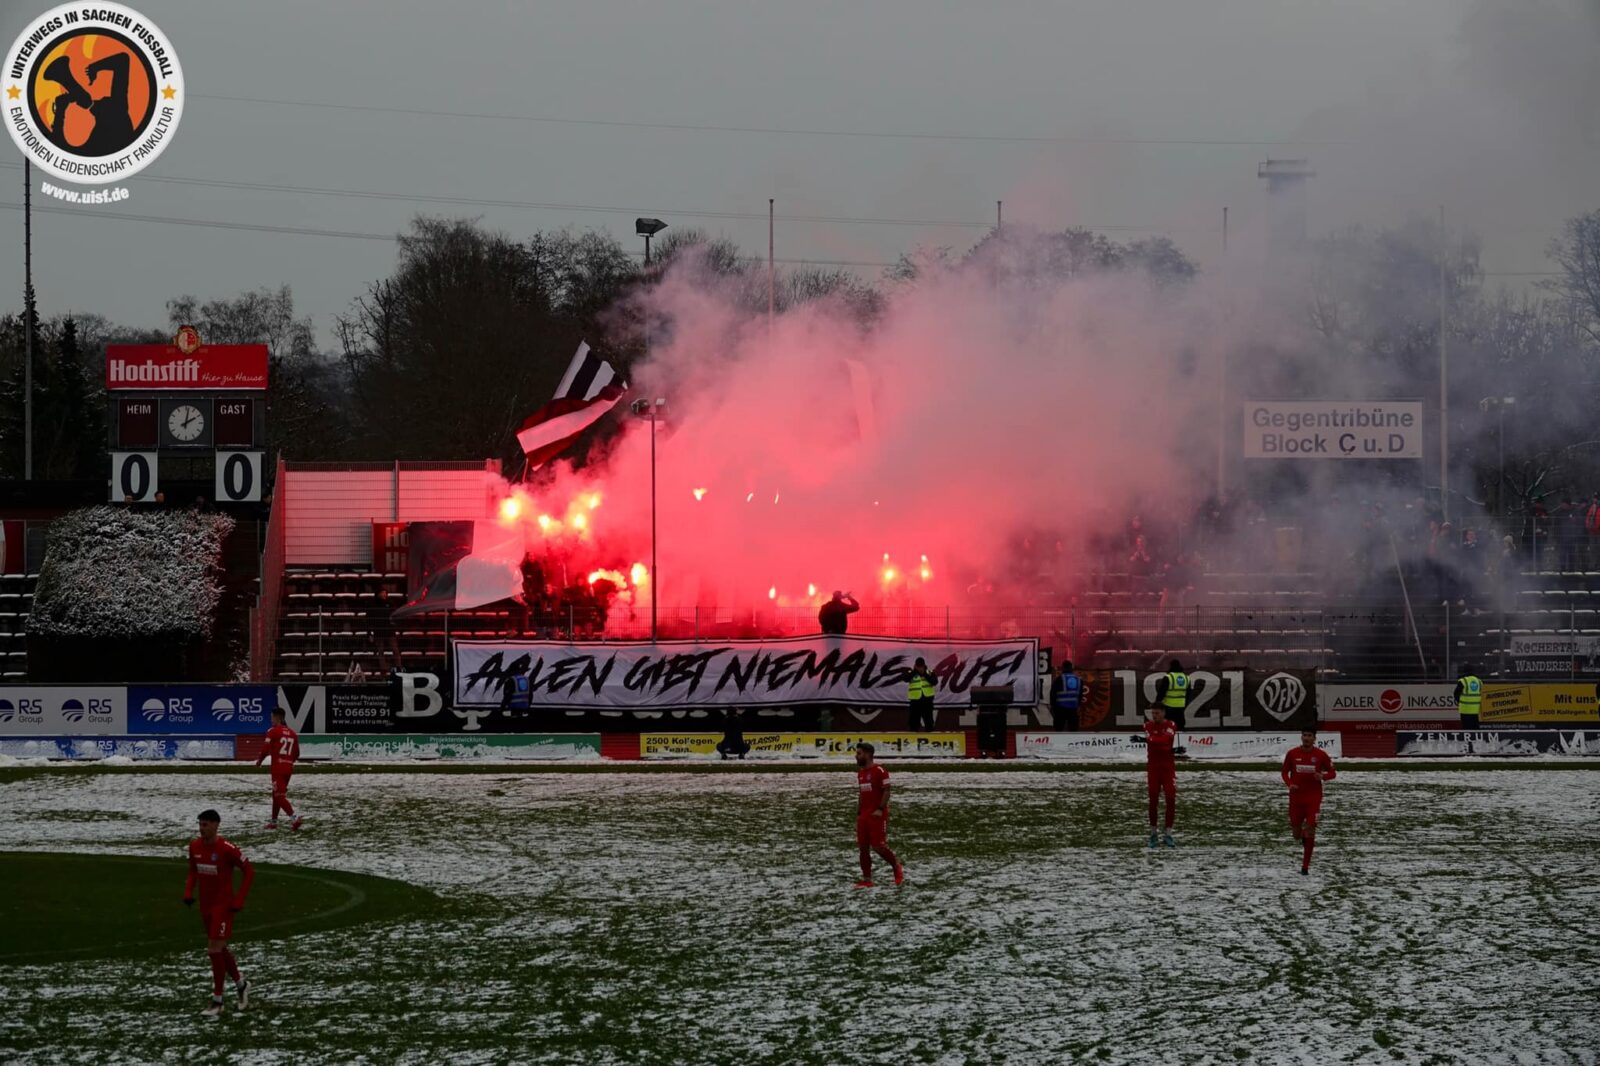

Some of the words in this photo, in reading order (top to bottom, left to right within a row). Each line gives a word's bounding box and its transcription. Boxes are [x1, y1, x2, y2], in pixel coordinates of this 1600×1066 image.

[110, 359, 200, 382] Hochstift
[126, 405, 151, 415] HEIM
[220, 405, 246, 415] GAST
[1253, 408, 1414, 431] Gegentribüne
[1262, 434, 1327, 452] Block
[1339, 433, 1356, 453] C
[1364, 439, 1382, 453] u.
[1389, 434, 1404, 452] D
[120, 454, 150, 501] 0
[223, 453, 253, 500] 0
[1515, 641, 1580, 653] KOCHERTAL
[463, 650, 618, 698] AALEN
[623, 647, 735, 700] GIBT
[711, 647, 912, 698] NIEMALS
[932, 645, 1027, 694] AUF!
[1333, 696, 1374, 707] ADLER
[1554, 694, 1572, 703] Mit
[1576, 696, 1596, 704] uns
[332, 708, 342, 716] T:
[344, 708, 377, 716] 06659
[18, 715, 43, 724] Group
[88, 715, 113, 724] Group
[169, 714, 194, 723] Group
[238, 714, 264, 722] Group
[1355, 720, 1443, 731] www.adler-inkasso.com
[430, 736, 487, 745] Projektentwicklung
[646, 737, 669, 745] 2500
[672, 737, 716, 747] Kollegen.
[1415, 732, 1499, 742] ZENTRUM
[279, 737, 294, 755] 27
[220, 922, 226, 933] 3
